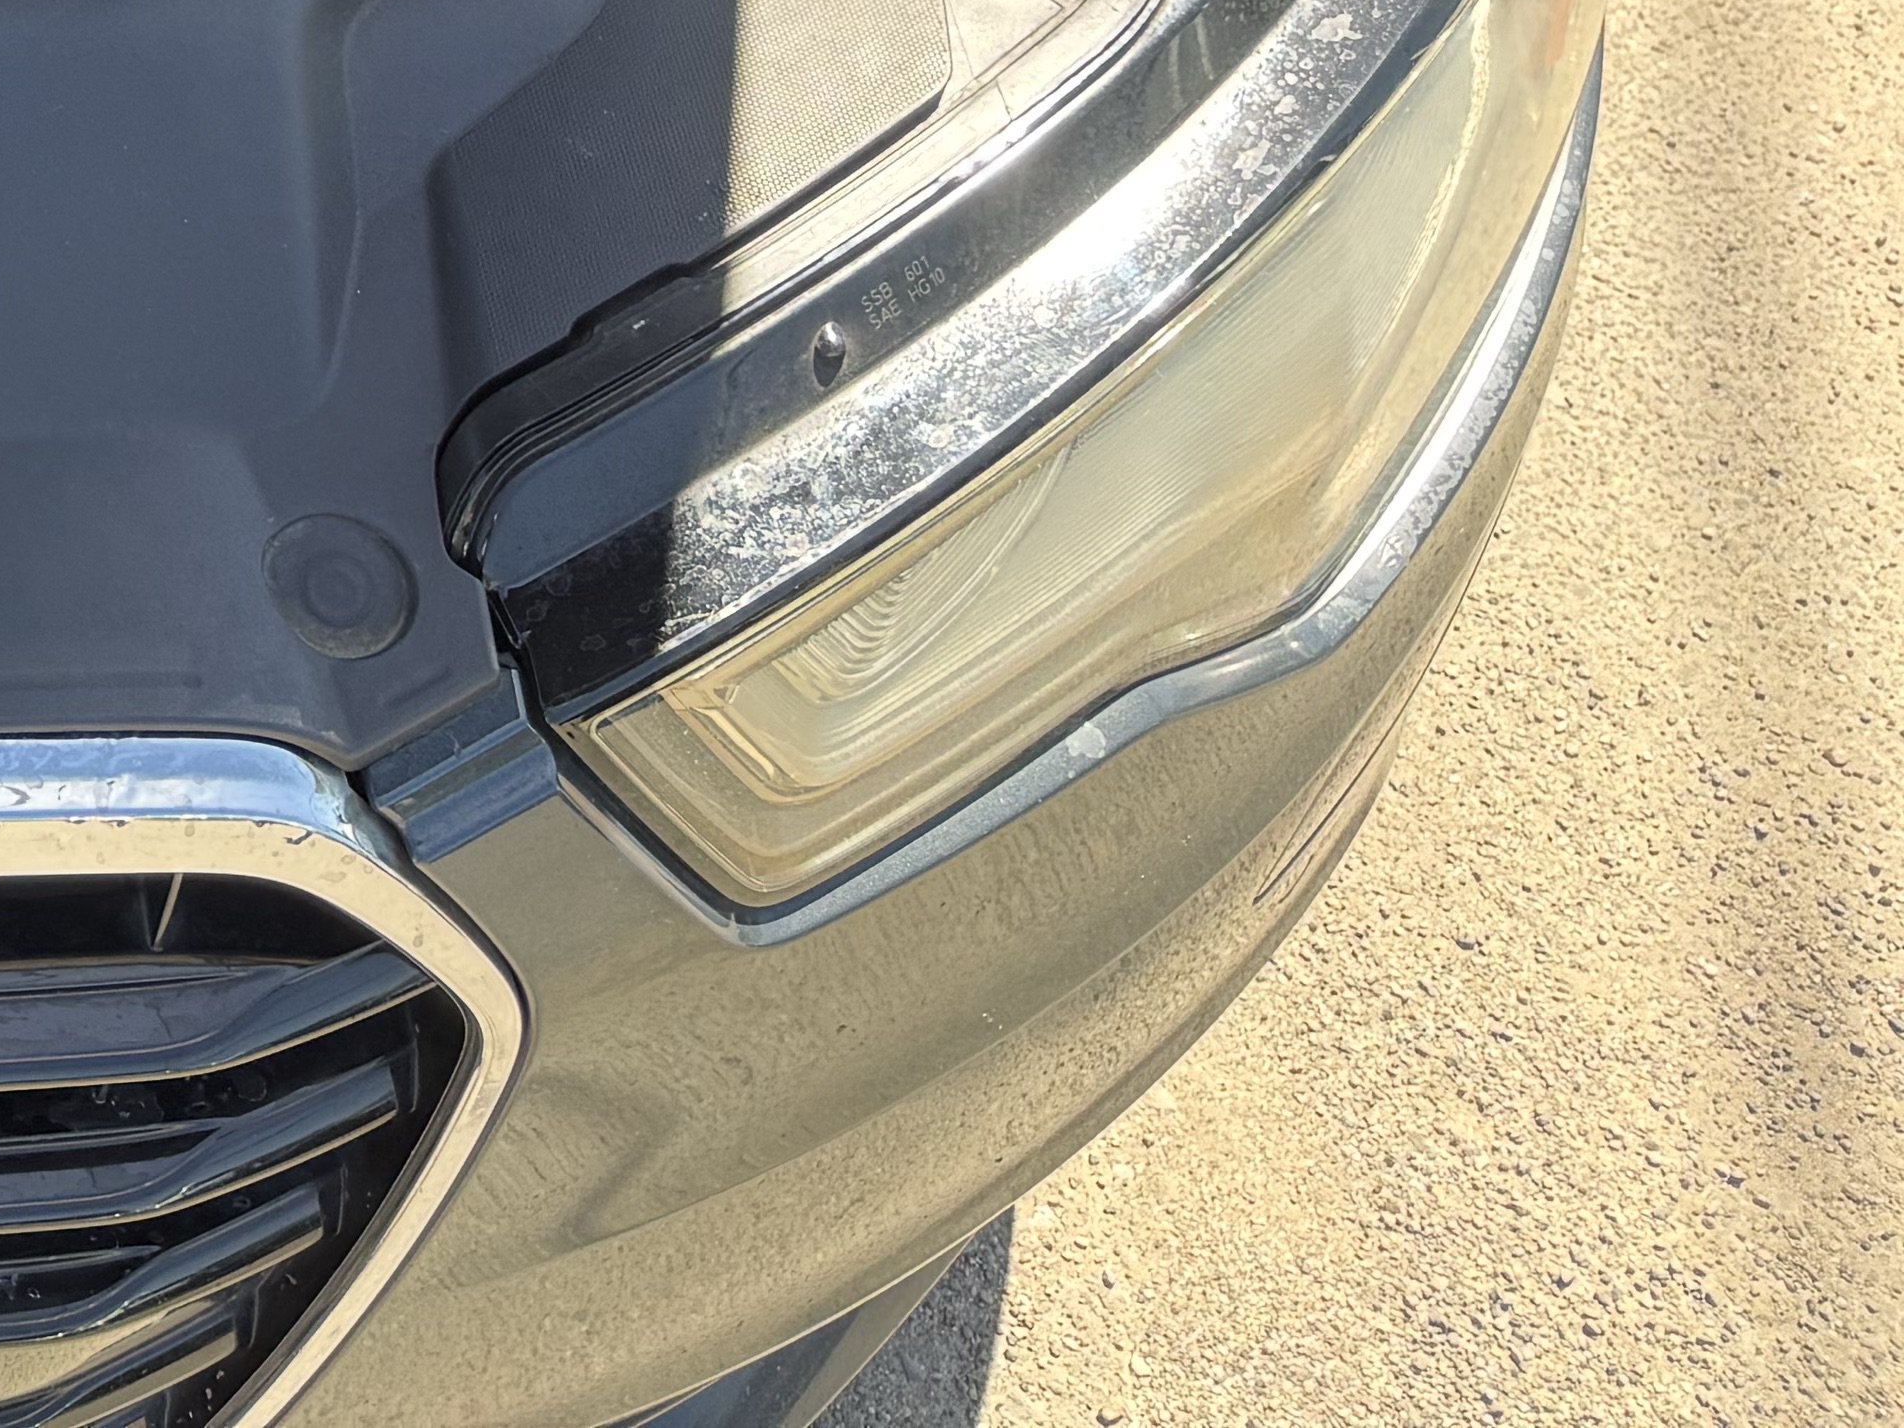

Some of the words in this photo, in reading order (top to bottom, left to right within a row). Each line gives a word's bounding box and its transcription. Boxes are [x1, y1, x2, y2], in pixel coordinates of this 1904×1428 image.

[861, 281, 893, 313] SSB
[904, 255, 930, 281] 601
[869, 298, 903, 330] SAE
